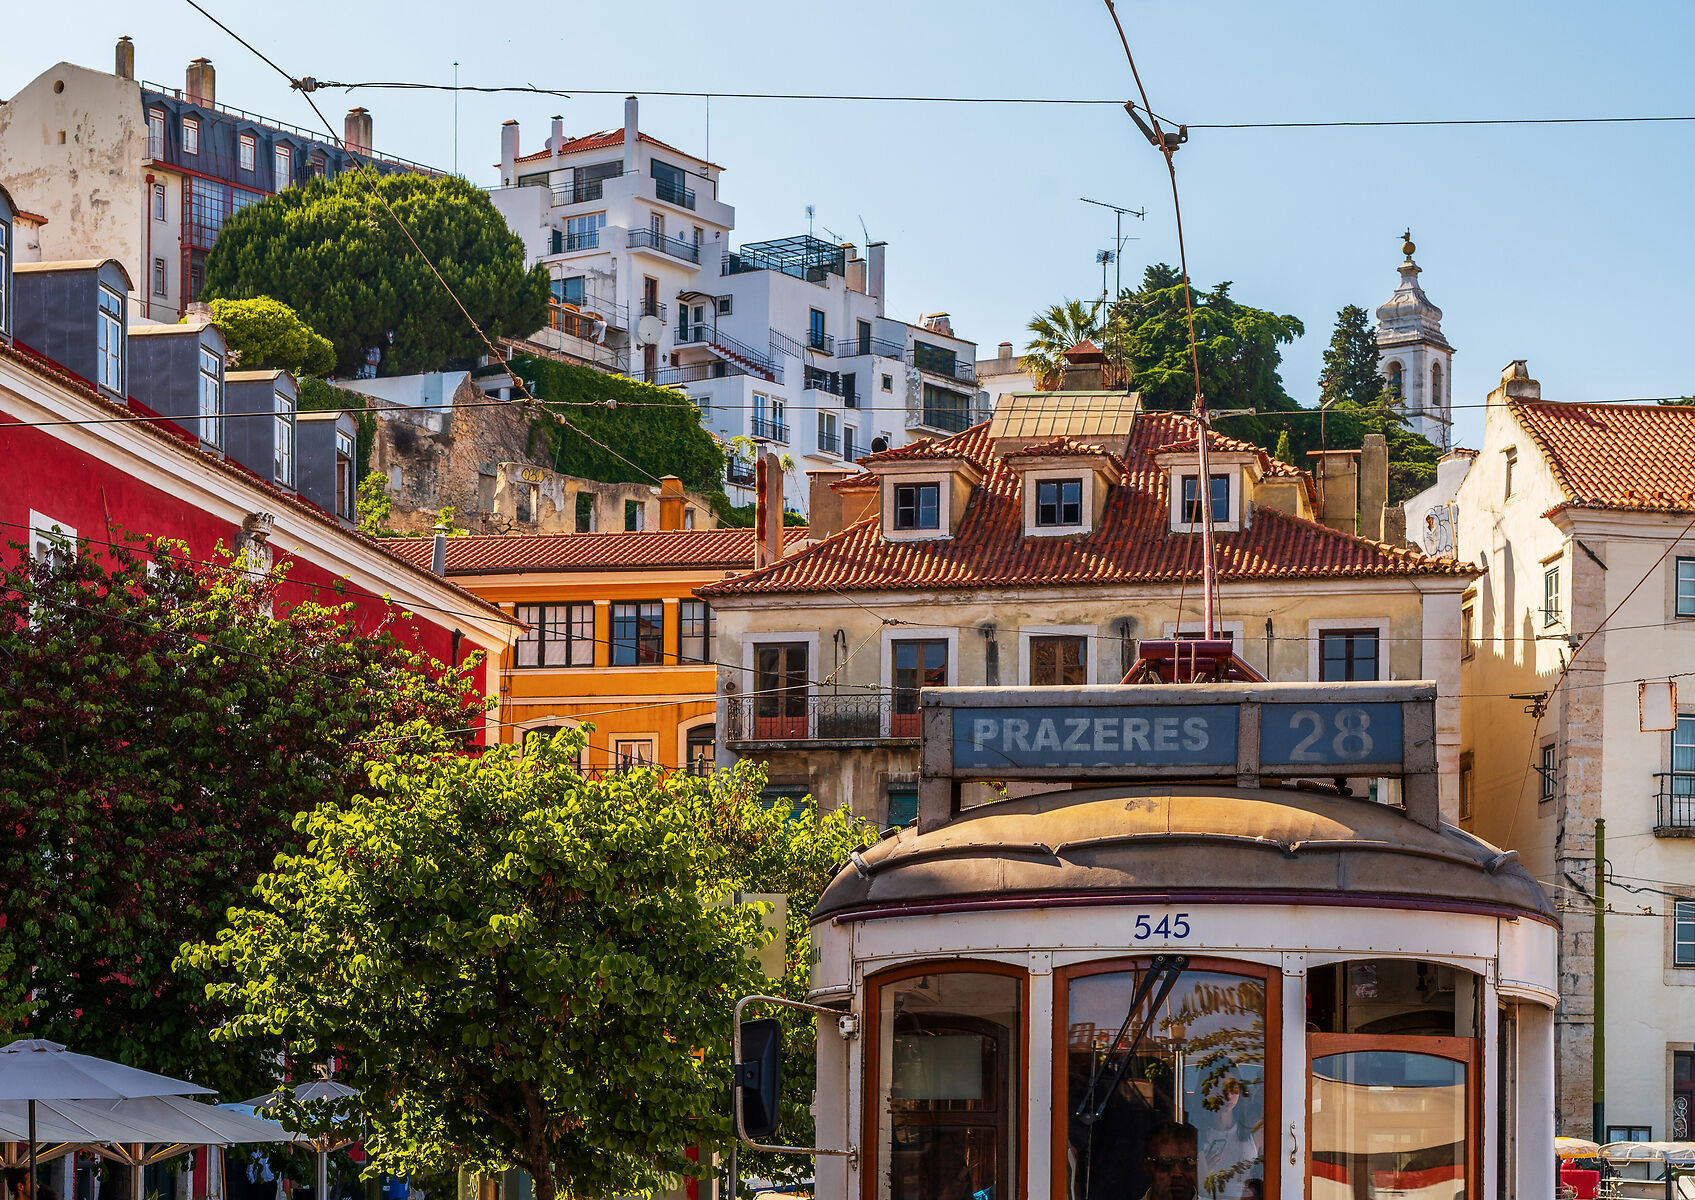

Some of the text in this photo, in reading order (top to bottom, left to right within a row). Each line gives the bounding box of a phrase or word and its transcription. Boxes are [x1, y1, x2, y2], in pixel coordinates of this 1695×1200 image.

[973, 717, 1209, 752] PRAZERES
[1289, 708, 1374, 761] 28
[1134, 913, 1190, 940] 545
